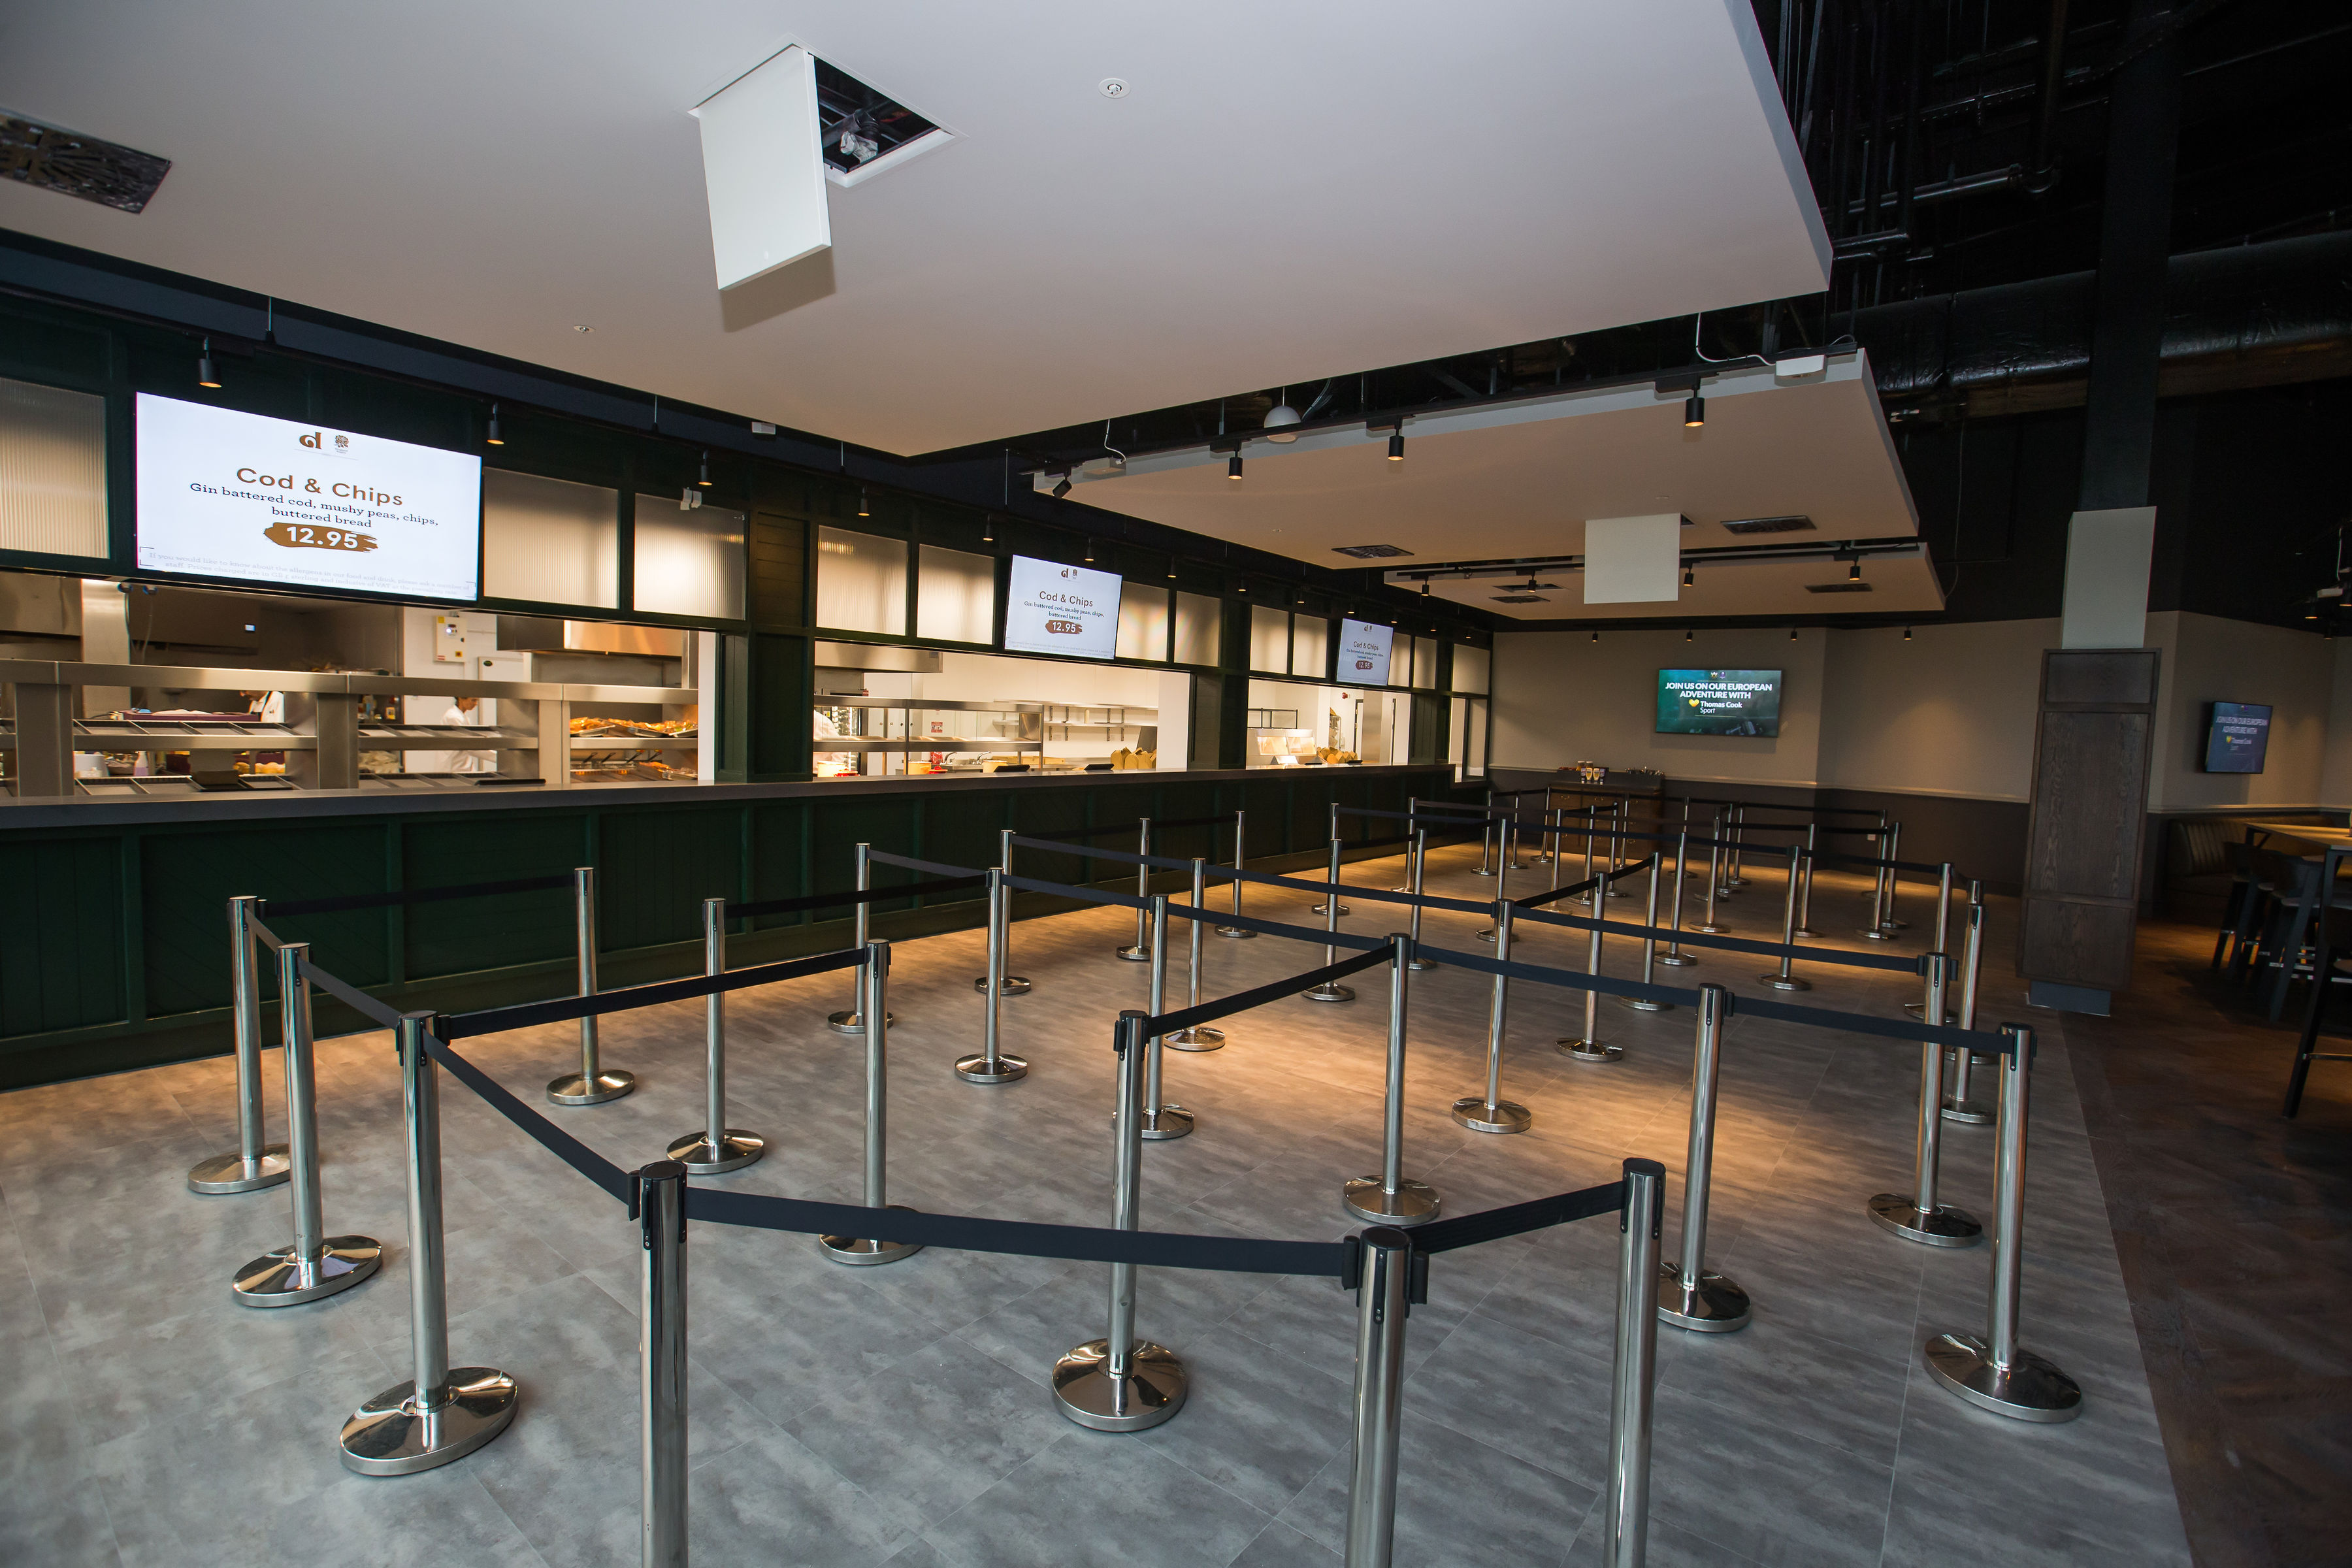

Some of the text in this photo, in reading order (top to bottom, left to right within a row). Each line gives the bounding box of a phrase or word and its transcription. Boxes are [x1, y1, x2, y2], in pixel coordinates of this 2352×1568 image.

[236, 467, 404, 506] Cod & Chips
[190, 482, 439, 527] Gin battered cod, mushy peas, chips,
[271, 506, 372, 528] buttered bread
[286, 525, 359, 549] 12.95
[1039, 591, 1093, 608] Cod & Chips
[1052, 622, 1076, 633] 12.95
